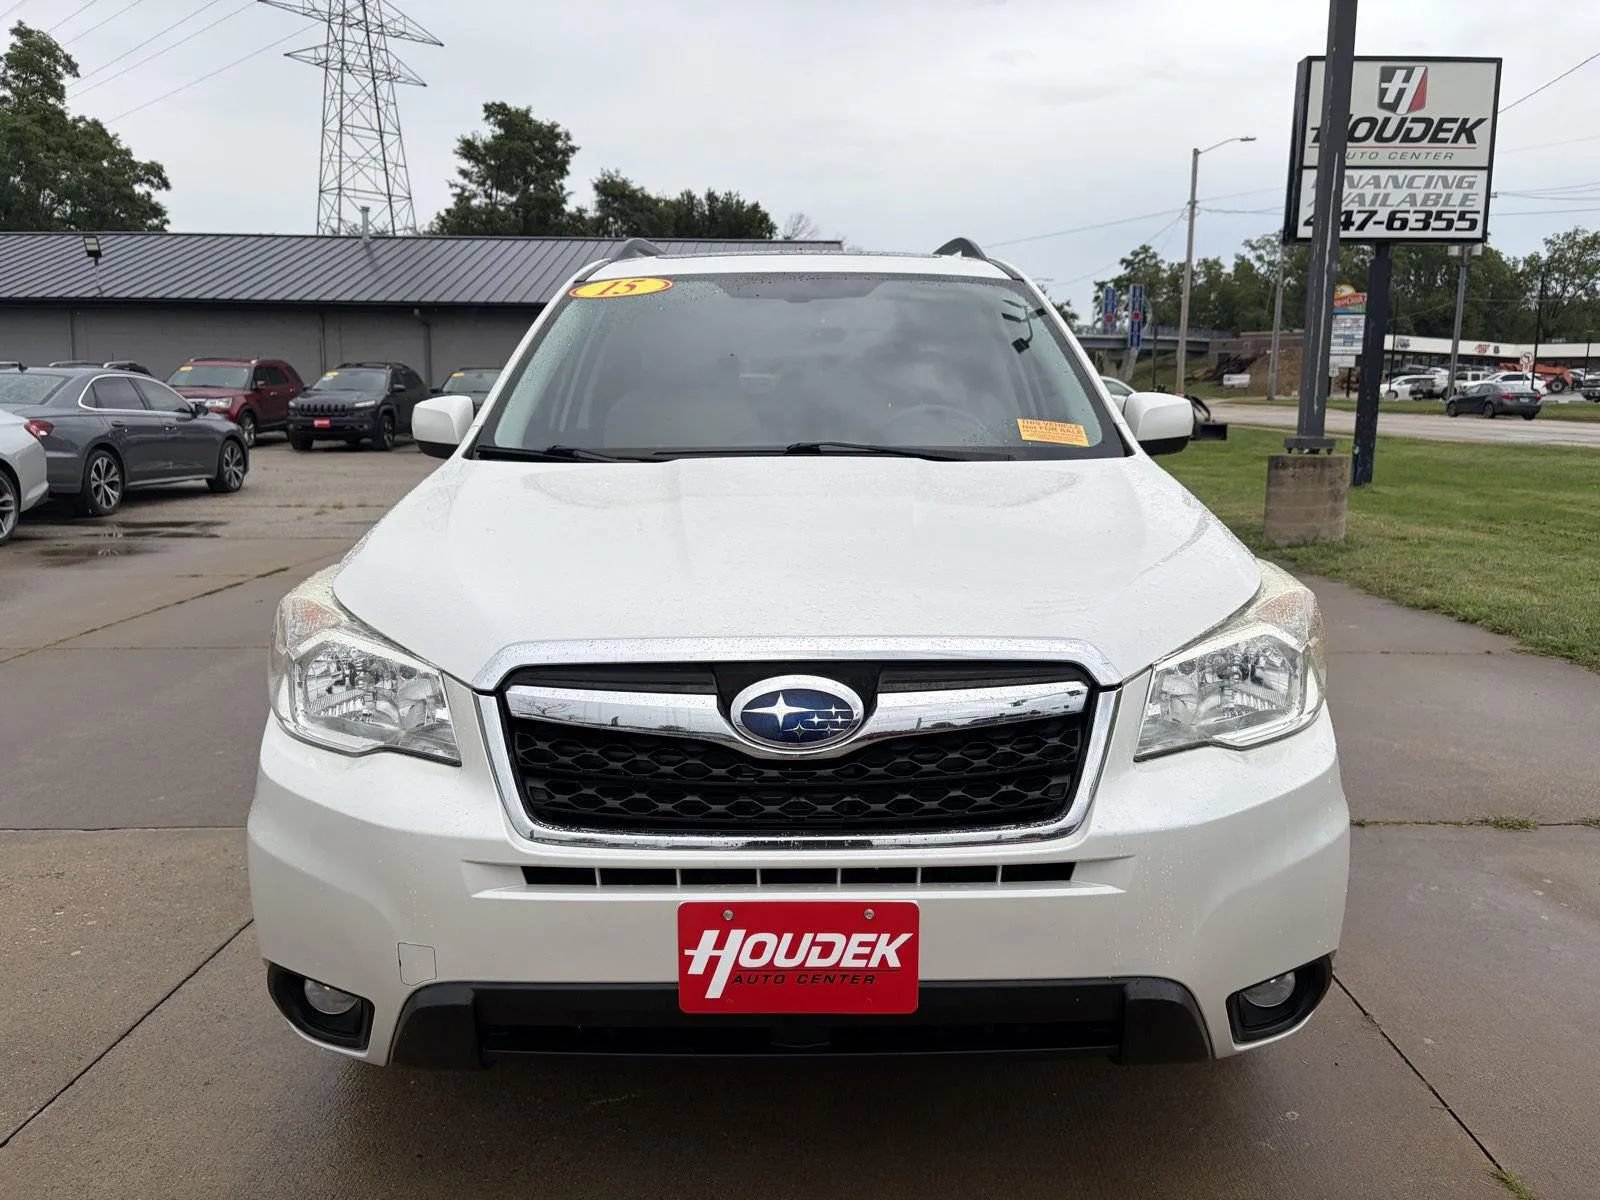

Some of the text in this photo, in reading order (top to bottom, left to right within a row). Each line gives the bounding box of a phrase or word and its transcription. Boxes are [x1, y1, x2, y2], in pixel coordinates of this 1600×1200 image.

[1310, 115, 1488, 144] OUDEK
[1344, 151, 1454, 161] UTO CENTER
[1311, 174, 1478, 189] NANCING
[1306, 192, 1479, 208] AILABLE
[684, 929, 914, 999] HOUDEK
[731, 974, 876, 985] AUTO CENTER
